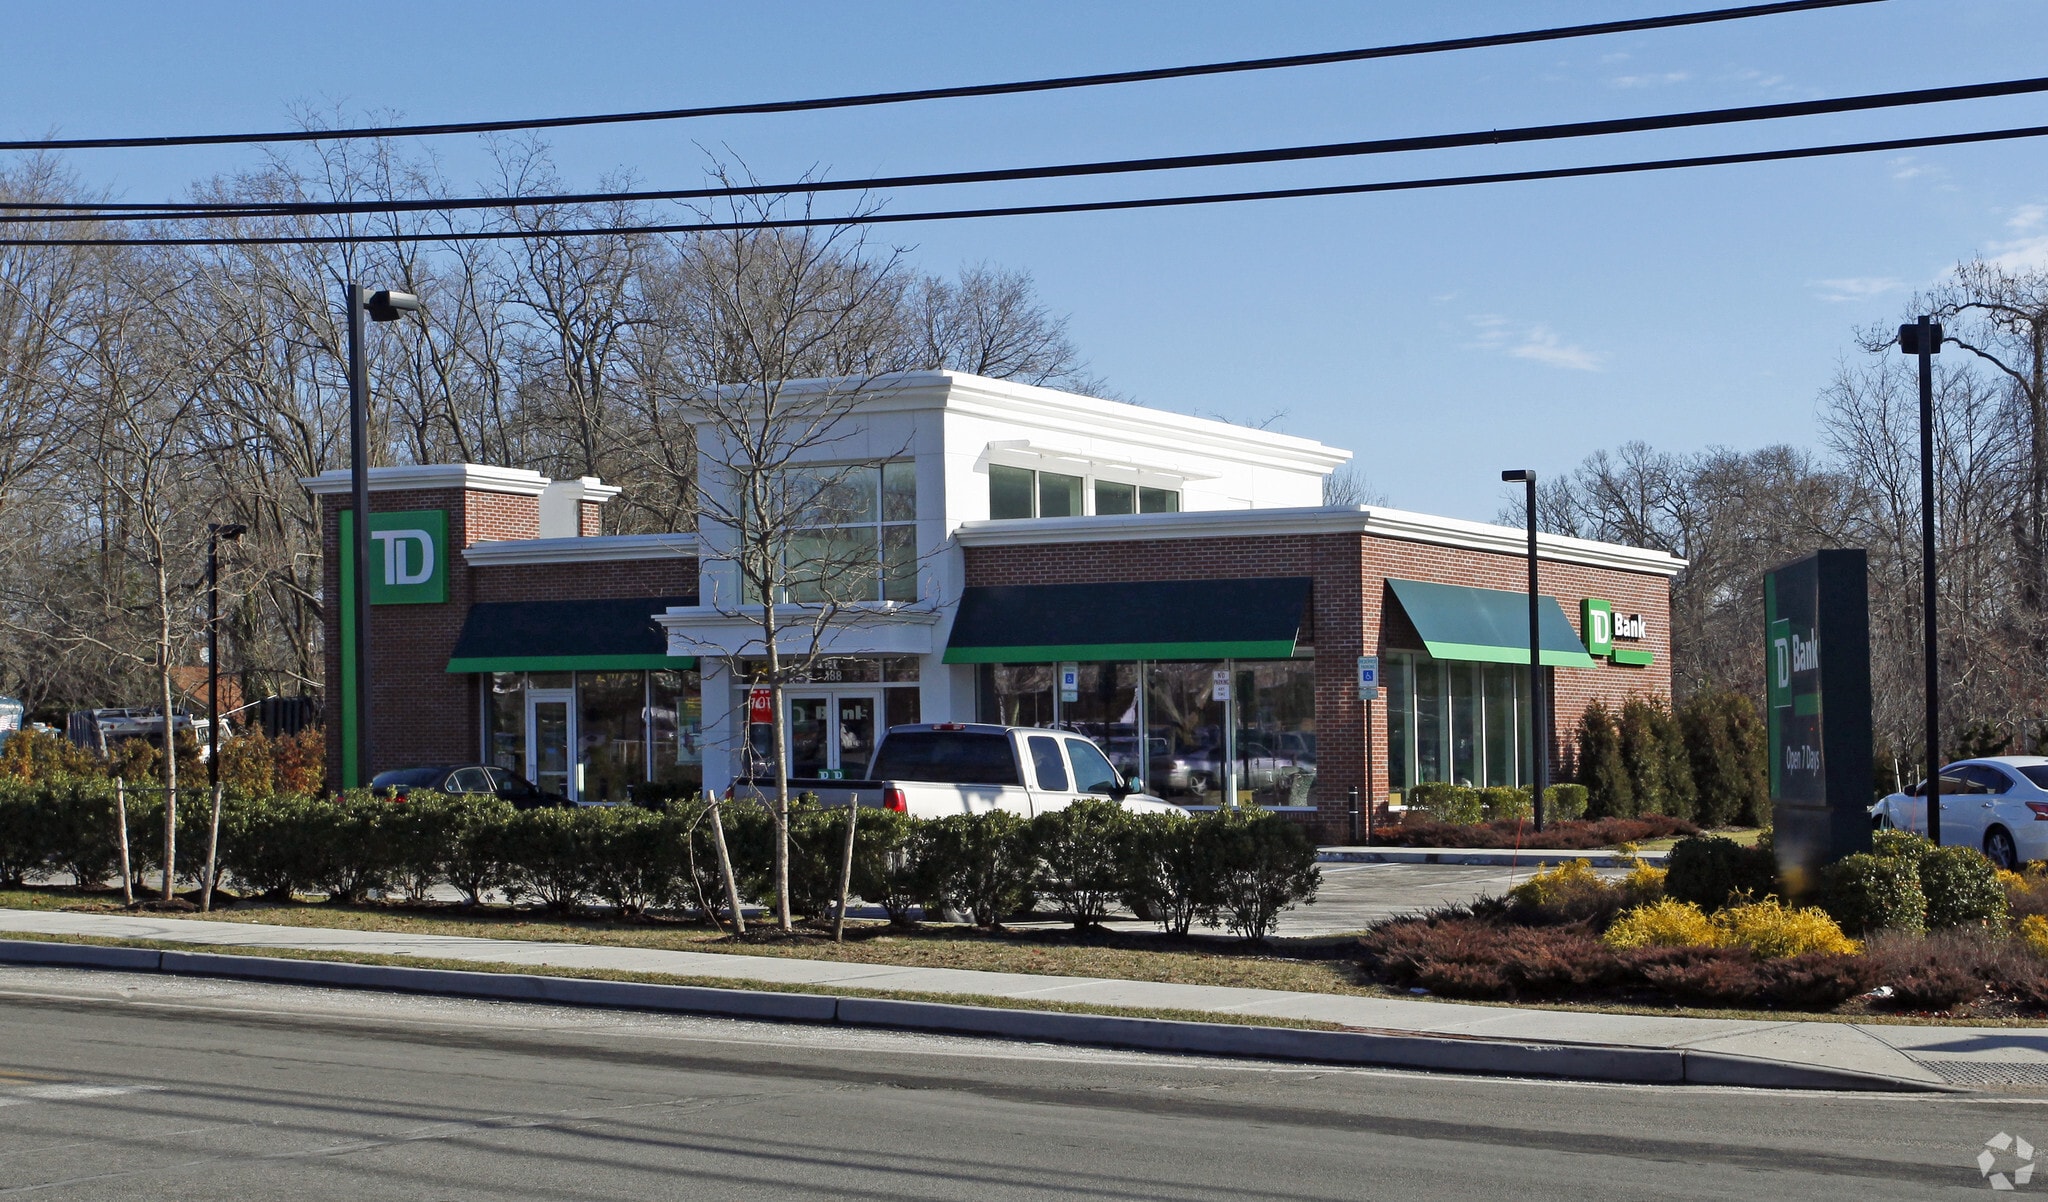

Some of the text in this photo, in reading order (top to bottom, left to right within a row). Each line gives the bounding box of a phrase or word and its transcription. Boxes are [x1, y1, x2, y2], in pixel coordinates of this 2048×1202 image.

[371, 529, 434, 585] TD
[1590, 609, 1647, 644] TD Bank
[1774, 627, 1819, 689] TD Bank
[815, 705, 868, 720] Bnk
[1786, 744, 1820, 777] Open 7 Days
